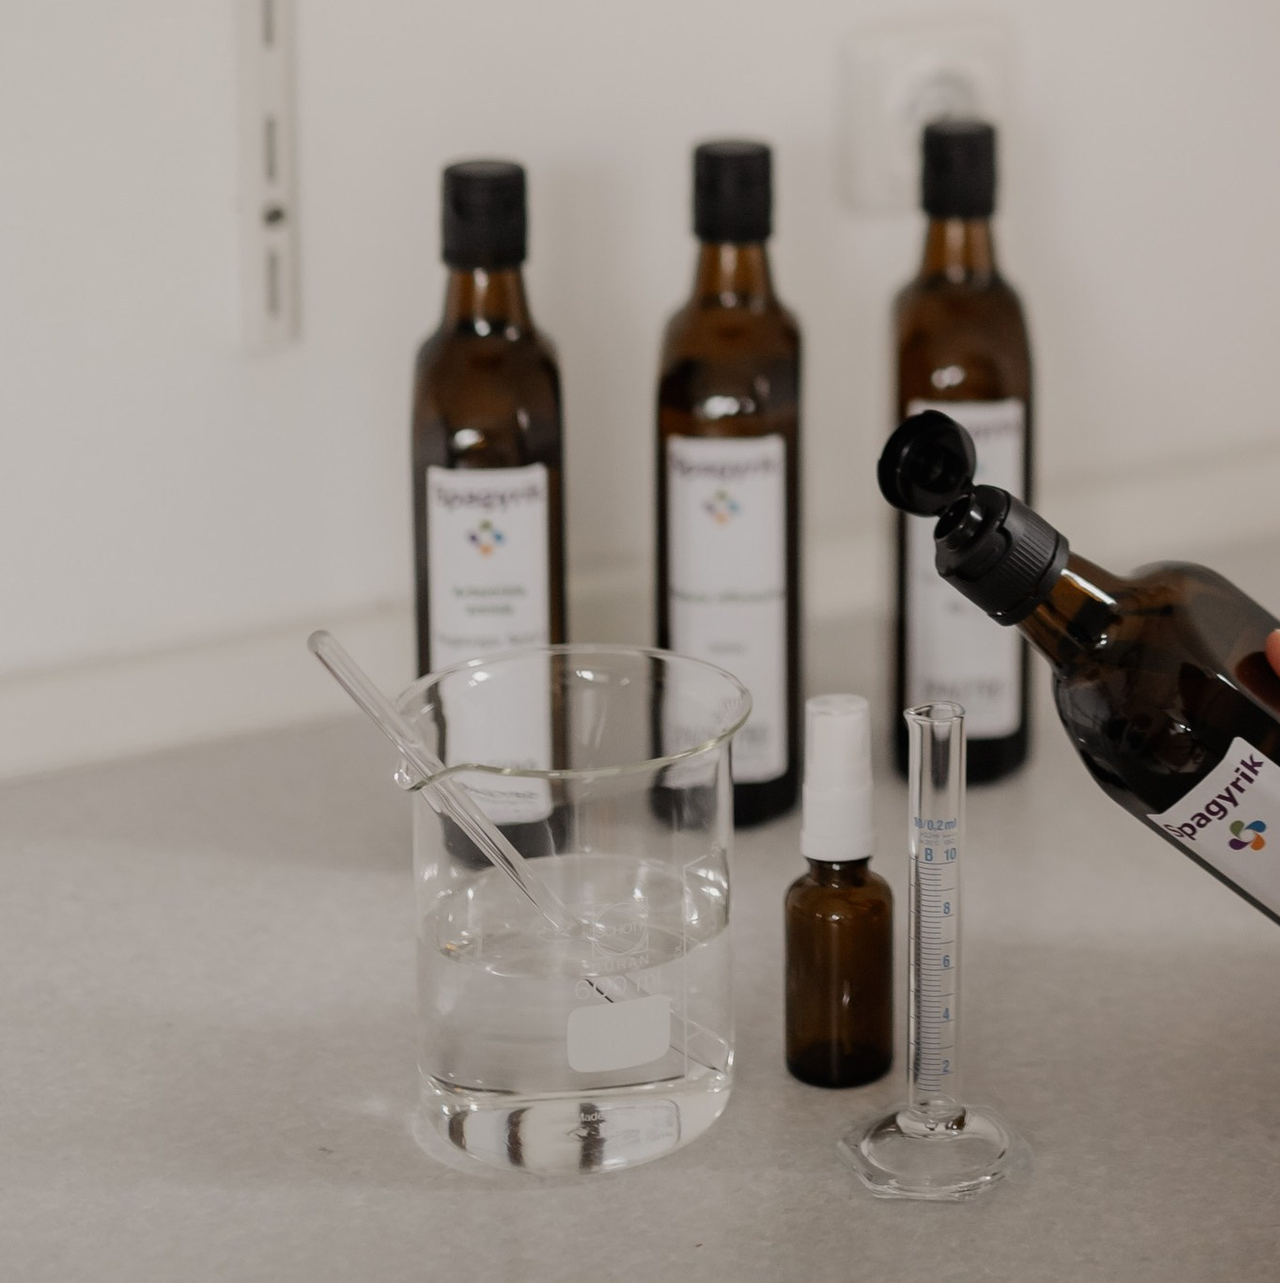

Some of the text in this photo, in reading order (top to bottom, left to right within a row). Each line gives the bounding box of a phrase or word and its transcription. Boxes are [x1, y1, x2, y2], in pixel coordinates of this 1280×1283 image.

[1163, 754, 1265, 841] Spagyrik
[925, 847, 957, 862] B 10
[943, 901, 951, 915] 8
[942, 954, 950, 968] 6
[942, 1007, 950, 1020] 4
[942, 1060, 950, 1073] 2
